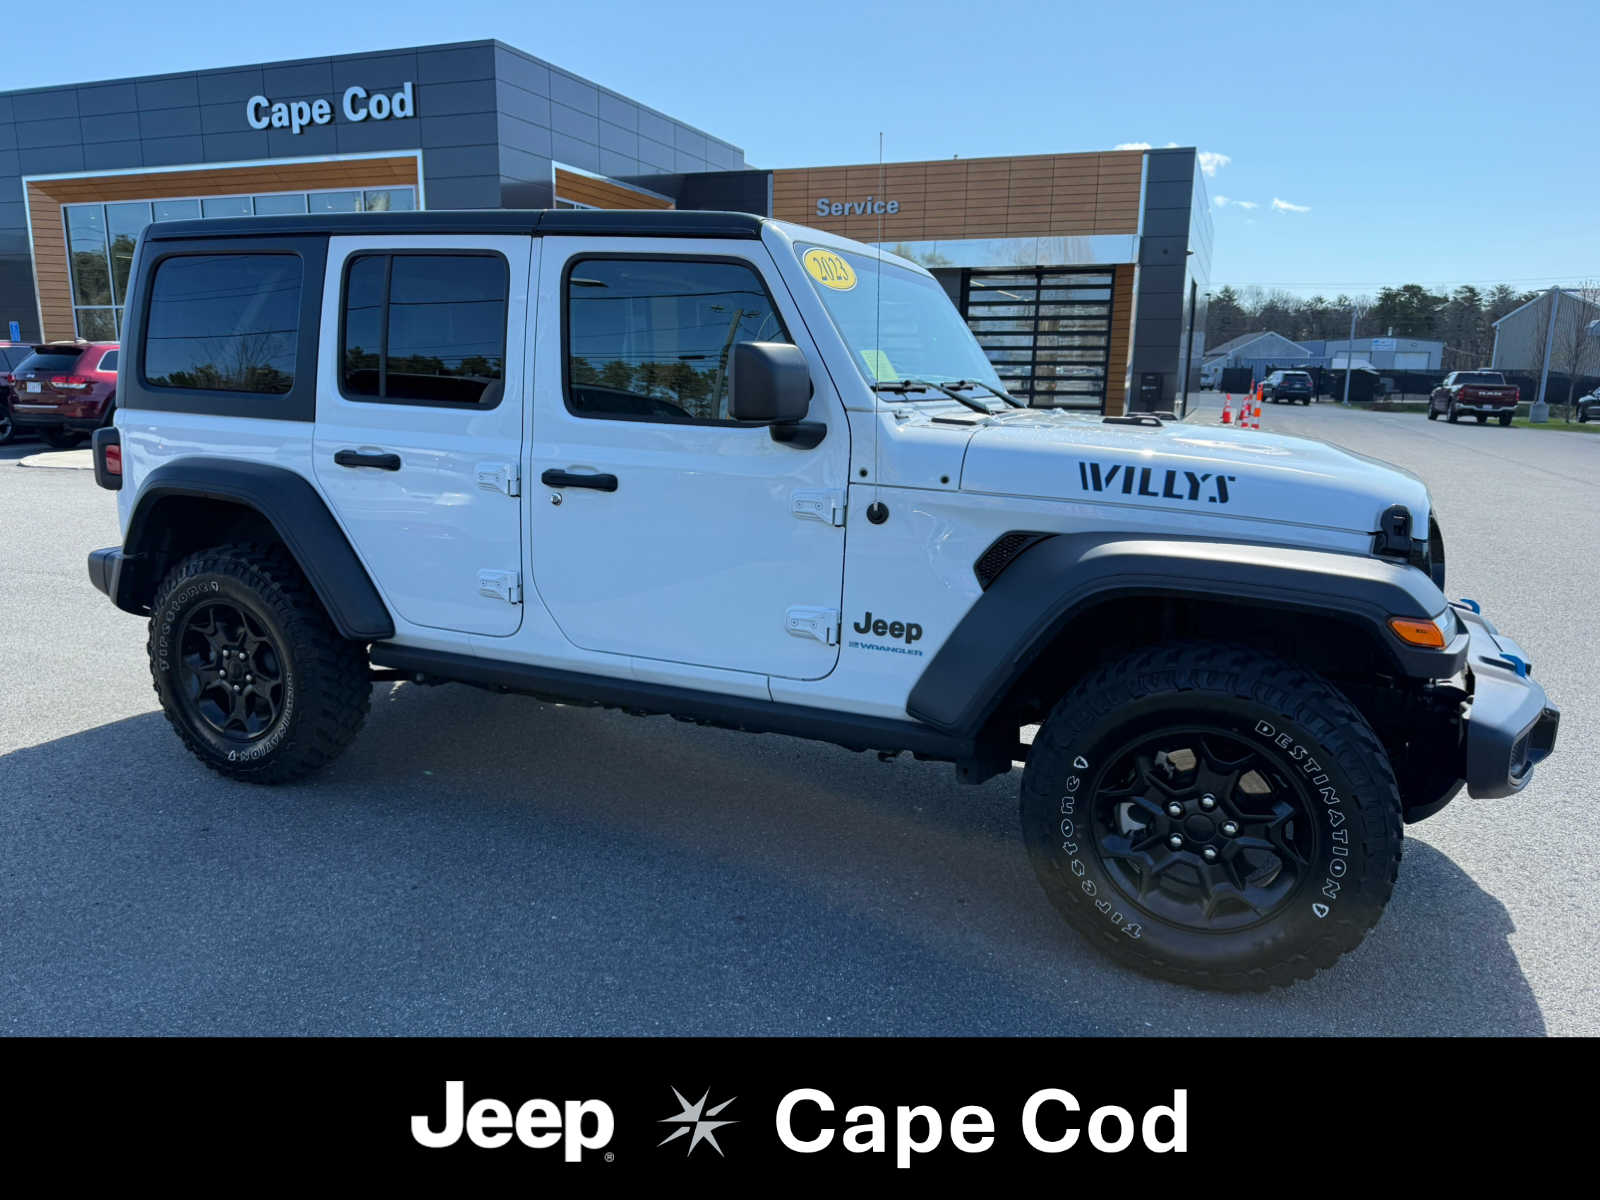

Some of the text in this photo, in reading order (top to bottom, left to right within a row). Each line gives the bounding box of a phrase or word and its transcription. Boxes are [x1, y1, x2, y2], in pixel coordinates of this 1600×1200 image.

[247, 81, 414, 134] Cape Cod
[816, 196, 899, 216] Service
[812, 257, 849, 281] 2023
[1079, 462, 1236, 504] WILLYS
[853, 611, 923, 644] Jeep
[860, 642, 923, 656] WRANGLER
[1254, 719, 1351, 900] DESTINATION
